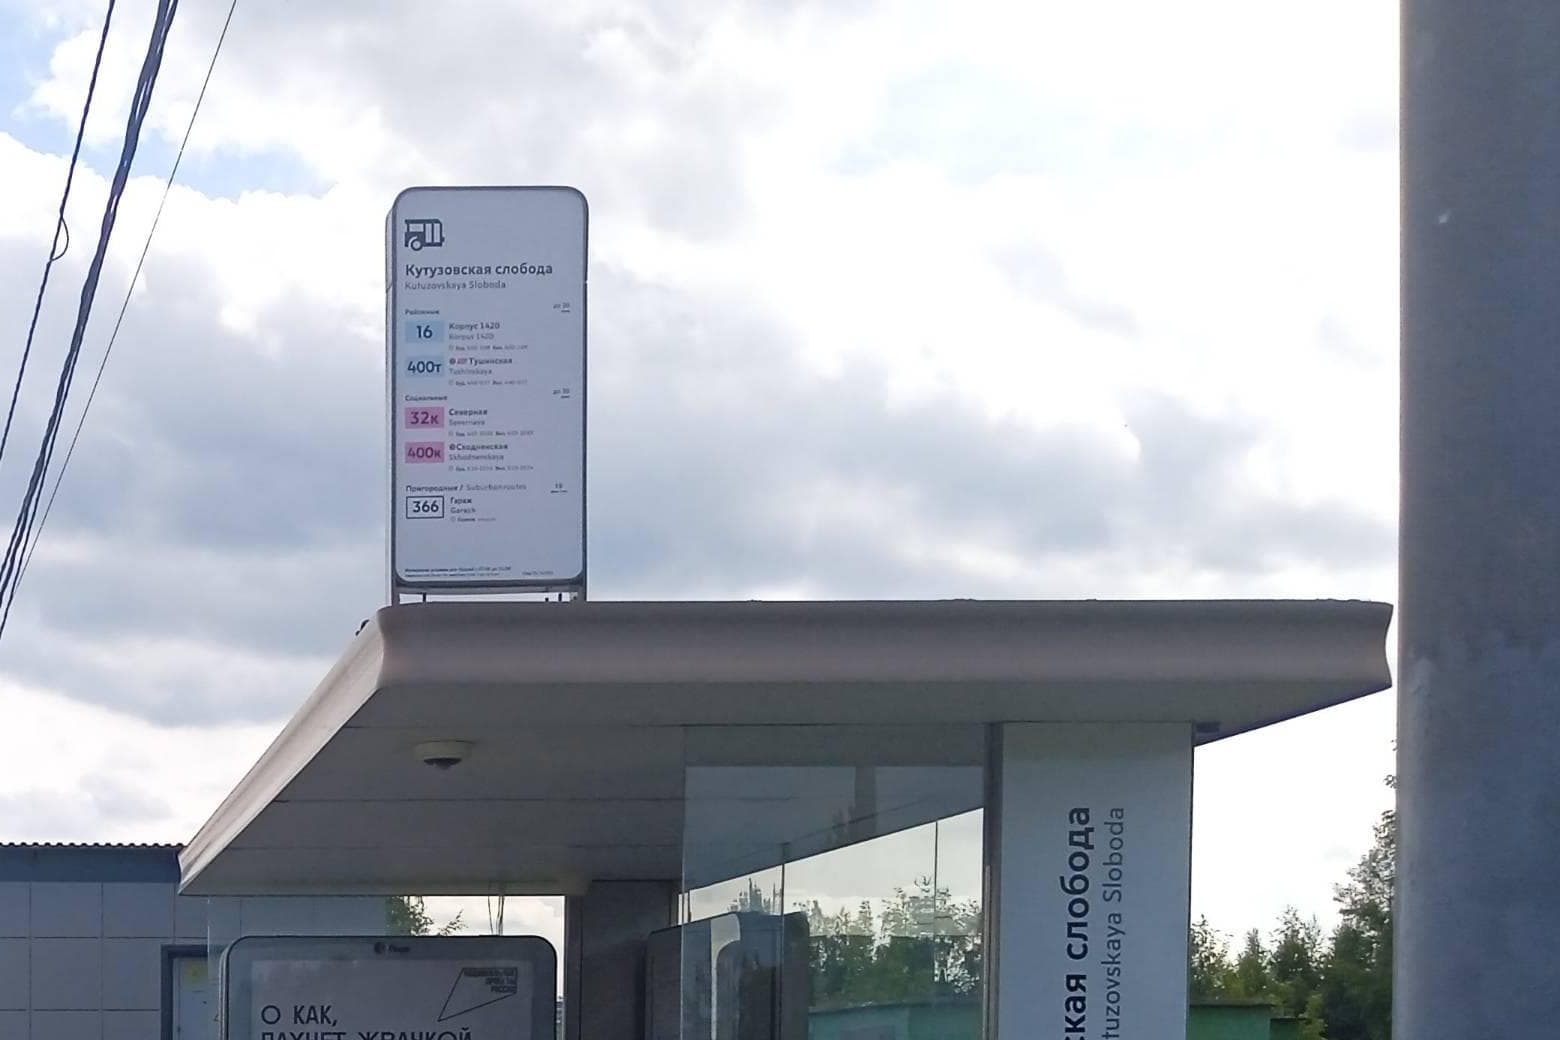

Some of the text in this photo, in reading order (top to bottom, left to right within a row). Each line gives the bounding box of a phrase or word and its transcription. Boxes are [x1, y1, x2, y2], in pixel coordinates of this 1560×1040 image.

[405, 262, 553, 278] Кутузовская слобода
[416, 325, 432, 339] 16
[407, 361, 442, 374] 400т
[410, 411, 439, 425] 32к
[407, 446, 442, 459] 400к
[412, 500, 439, 513] 366
[1102, 807, 1125, 903] Sloboda
[1060, 807, 1095, 960] слобода
[261, 1005, 338, 1027] О КАК,
